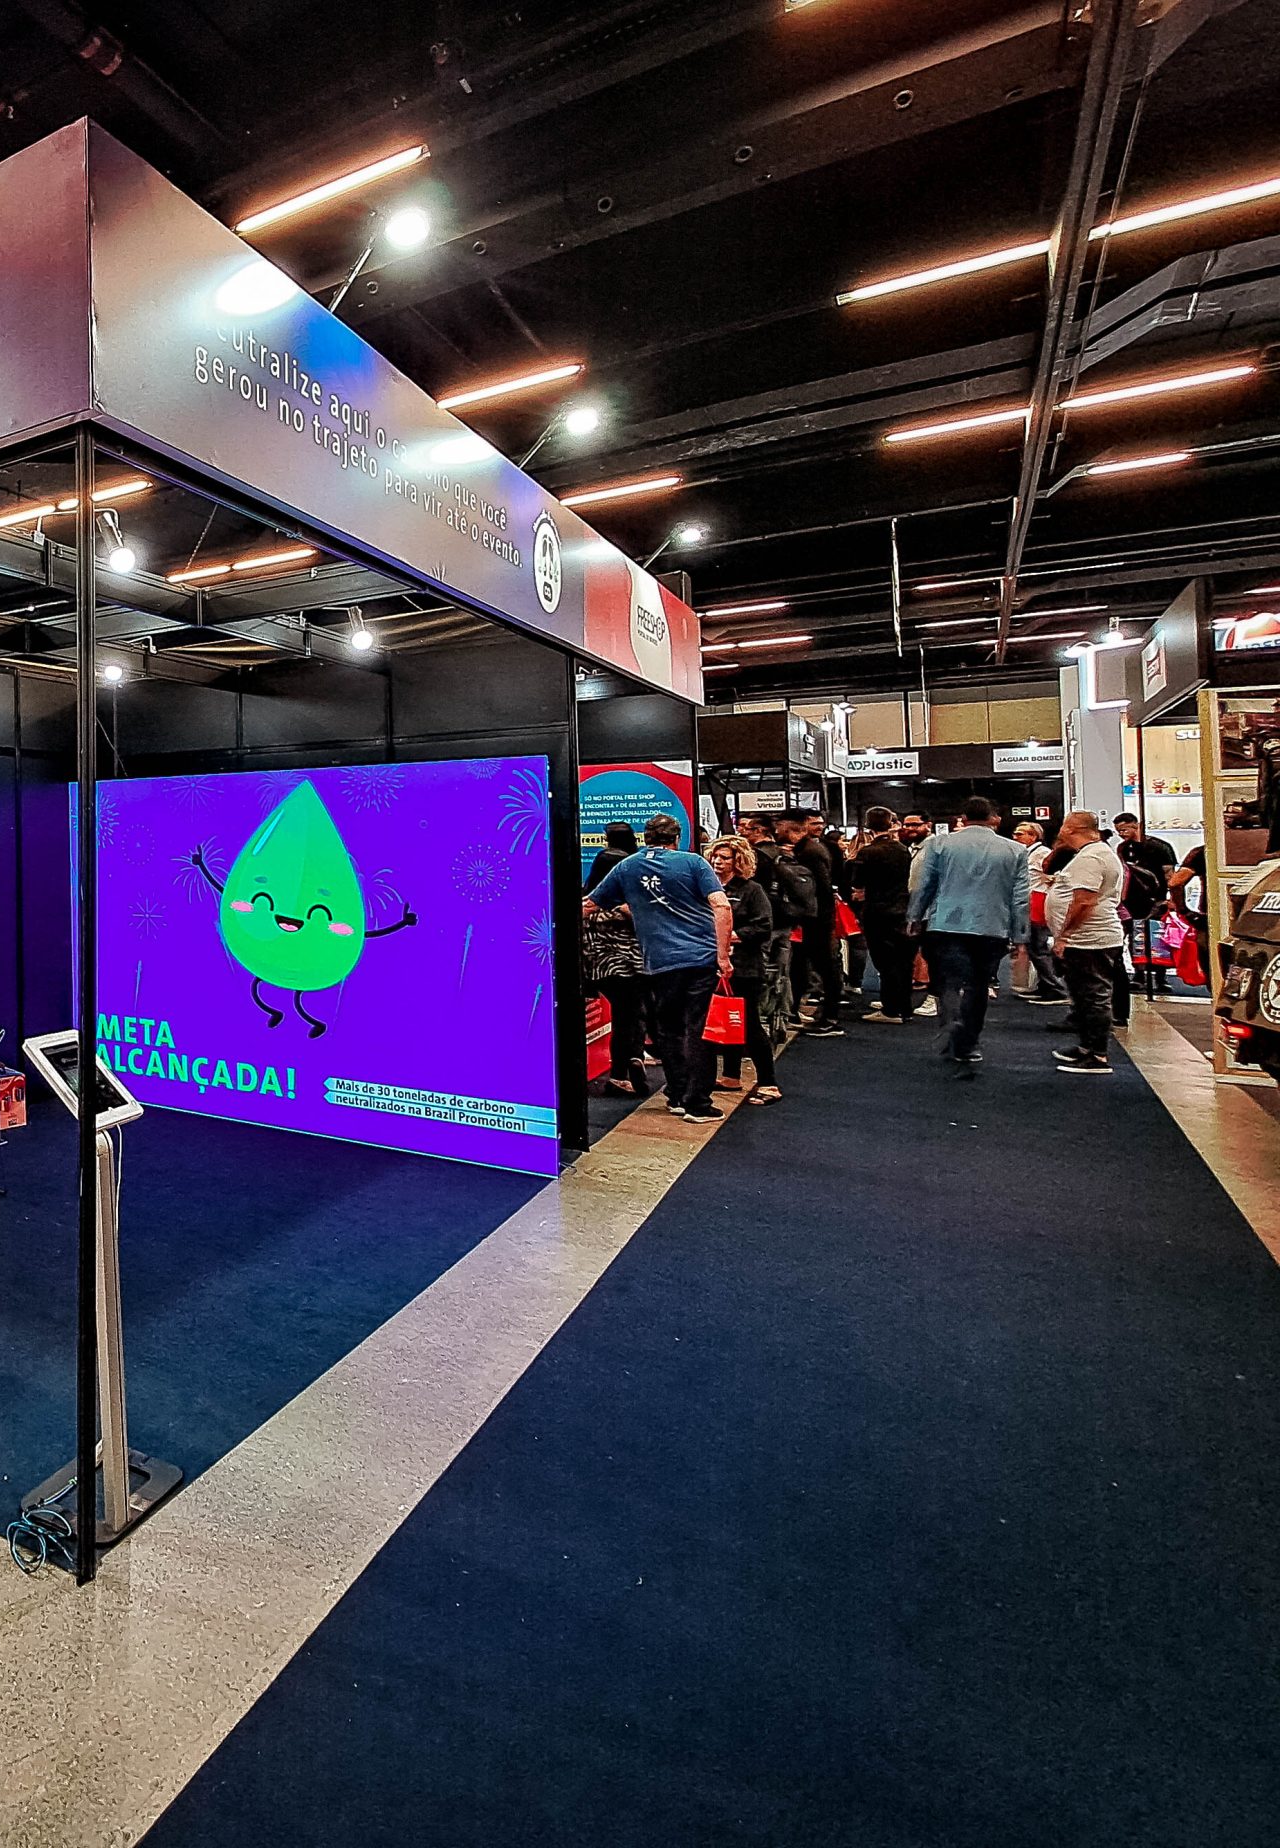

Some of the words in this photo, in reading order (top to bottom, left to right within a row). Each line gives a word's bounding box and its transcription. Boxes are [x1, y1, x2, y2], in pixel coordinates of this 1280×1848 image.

[216, 325, 322, 406] utralize
[329, 393, 370, 438] aqui
[376, 427, 386, 449] o
[453, 482, 477, 511] que
[480, 499, 507, 530] você
[195, 345, 268, 411] gerou
[278, 397, 305, 432] no
[312, 414, 378, 478] trajeto
[385, 467, 417, 504] para
[422, 491, 442, 519] vir
[446, 507, 468, 535] até
[471, 523, 479, 541] o
[482, 530, 524, 569] evento.
[96, 1013, 176, 1049] META
[96, 1043, 296, 1100] ALCANÇADA!
[335, 1079, 360, 1093] Mais
[361, 1083, 375, 1095] de
[377, 1085, 390, 1097] 30
[393, 1087, 447, 1106] toneladas
[449, 1095, 464, 1108] de
[466, 1099, 515, 1115] carbono
[335, 1094, 406, 1113] neutralizados
[408, 1104, 422, 1115] na
[424, 1106, 456, 1121] Brazil
